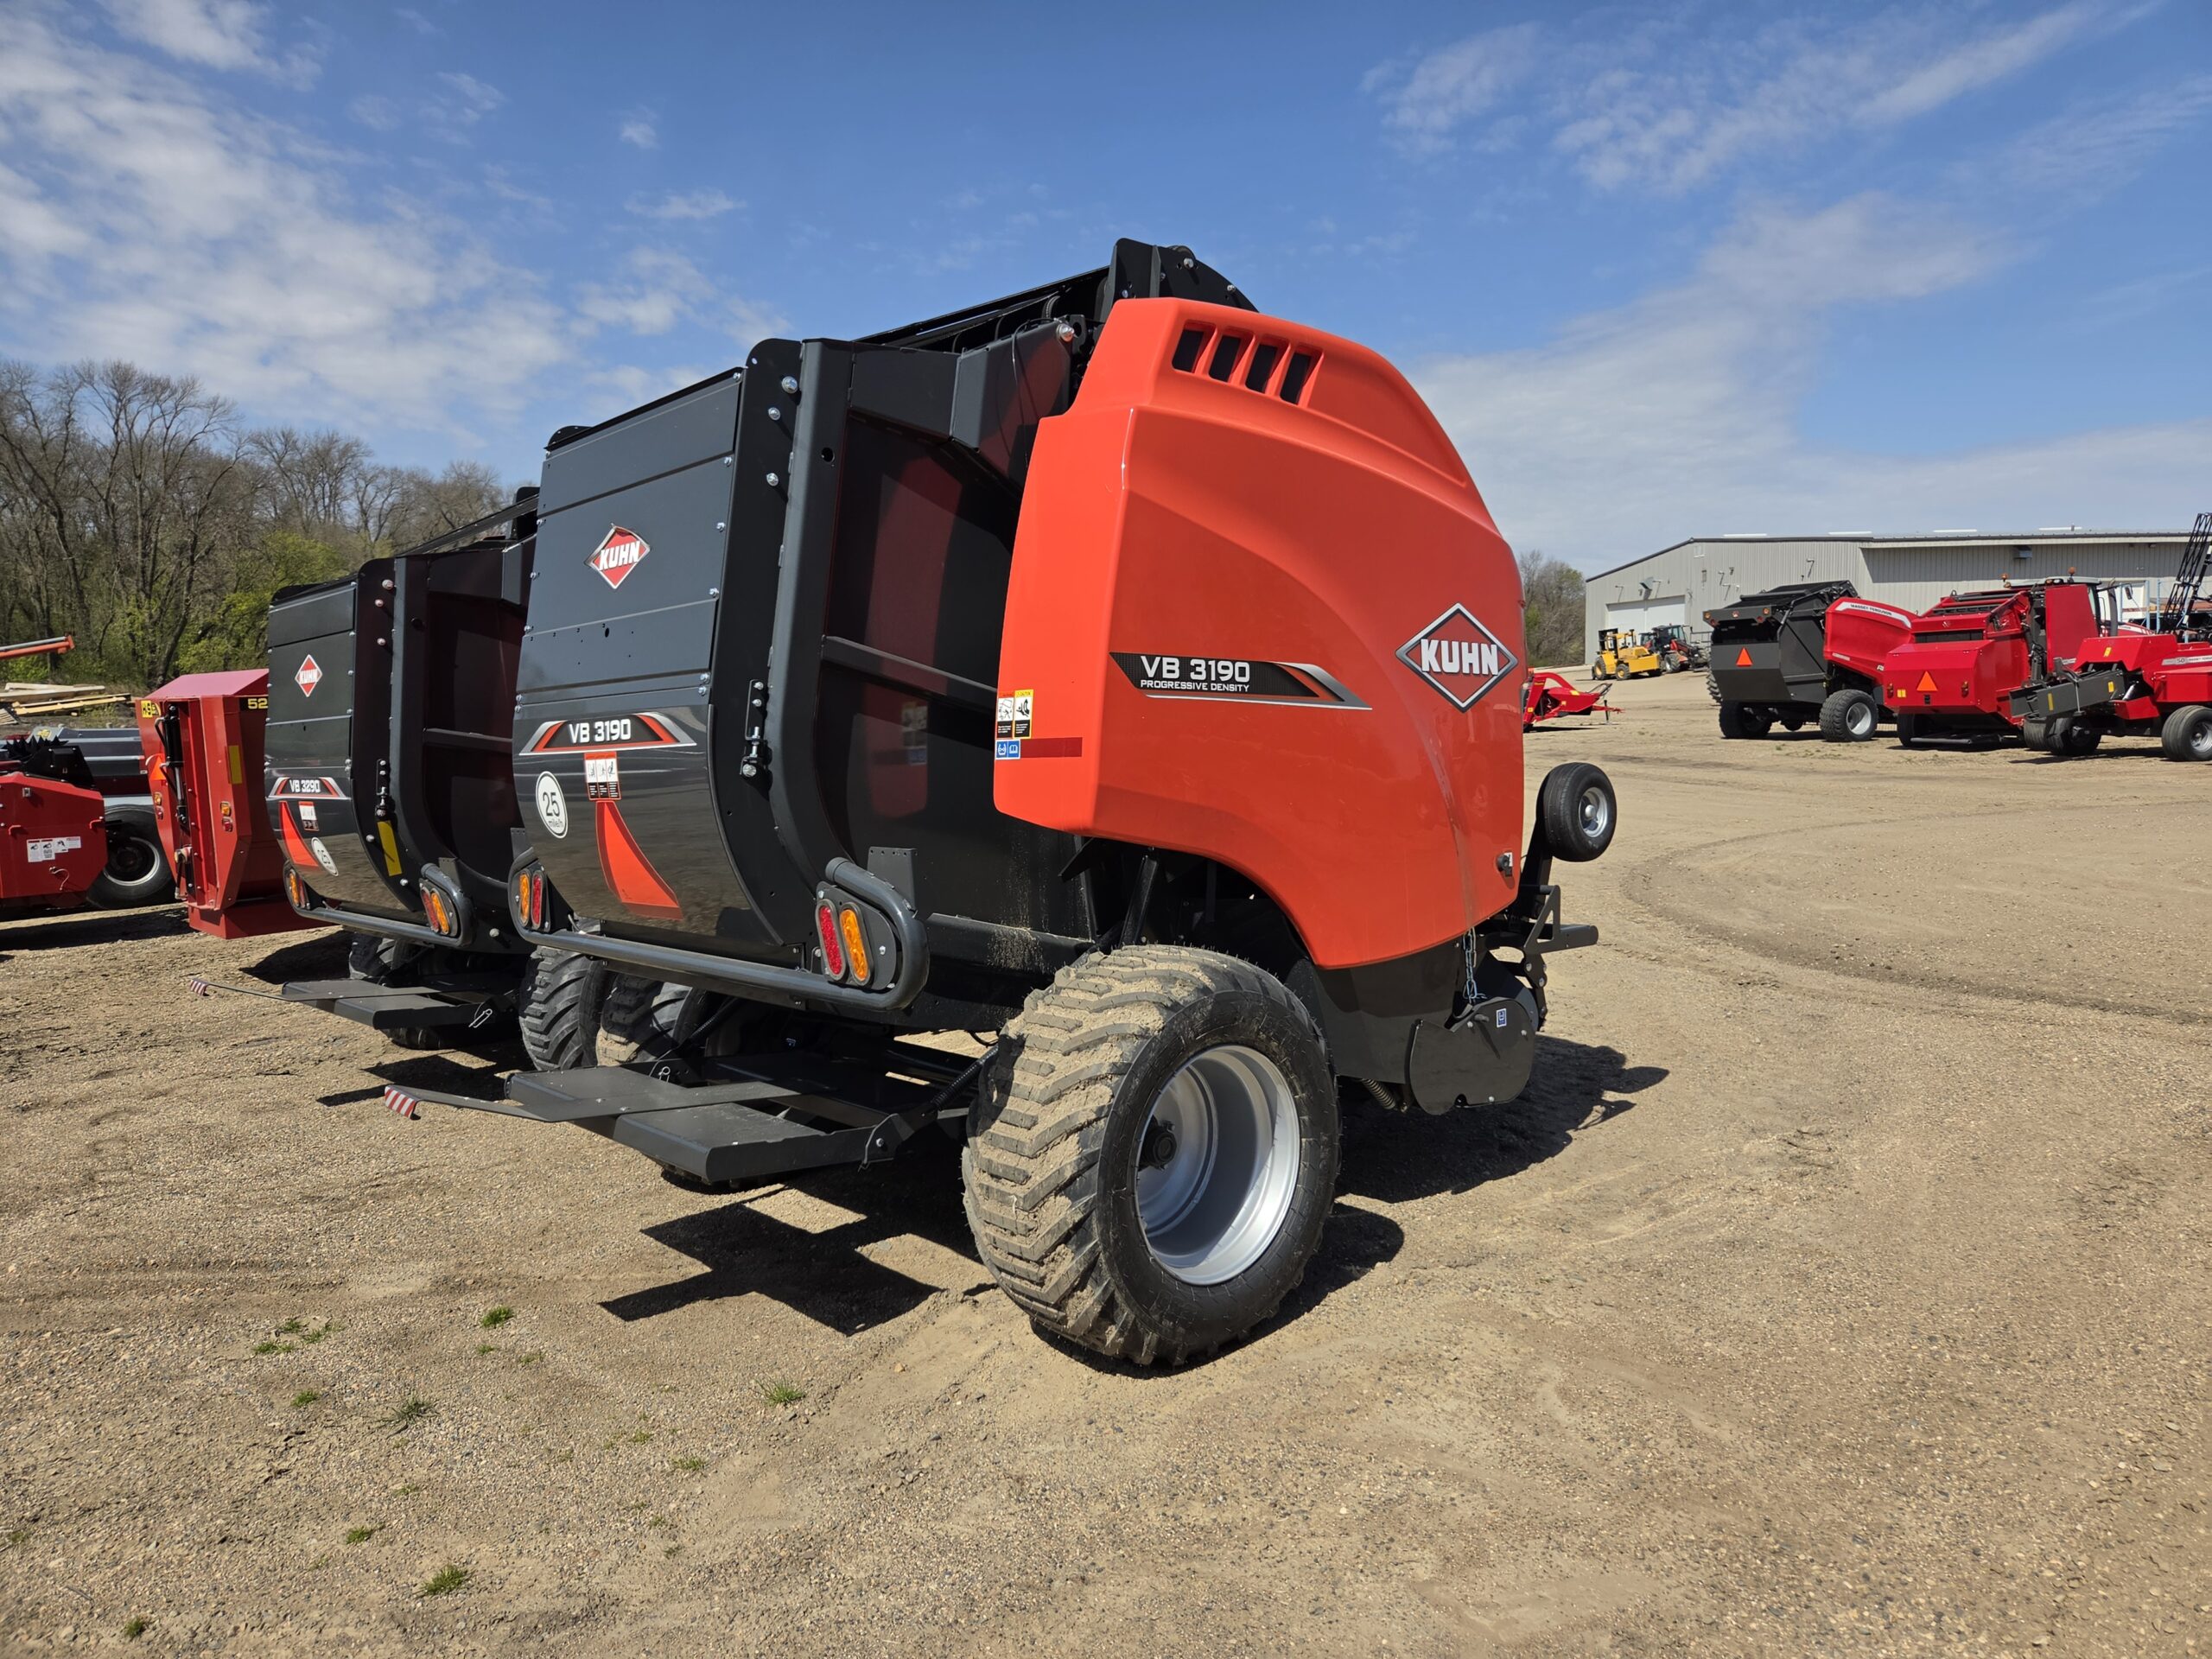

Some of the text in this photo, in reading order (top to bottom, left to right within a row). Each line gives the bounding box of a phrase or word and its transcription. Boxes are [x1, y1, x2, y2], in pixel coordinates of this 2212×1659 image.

[599, 540, 640, 571] KUHN
[1141, 656, 1250, 683] VB 3190
[1421, 639, 1498, 676] KUHN
[299, 668, 318, 684] KUHN
[1141, 679, 1249, 692] PROGRESSIVE DENSITY
[569, 719, 631, 743] VB 3190
[289, 779, 321, 793] VB 3290
[542, 791, 561, 817] 25
